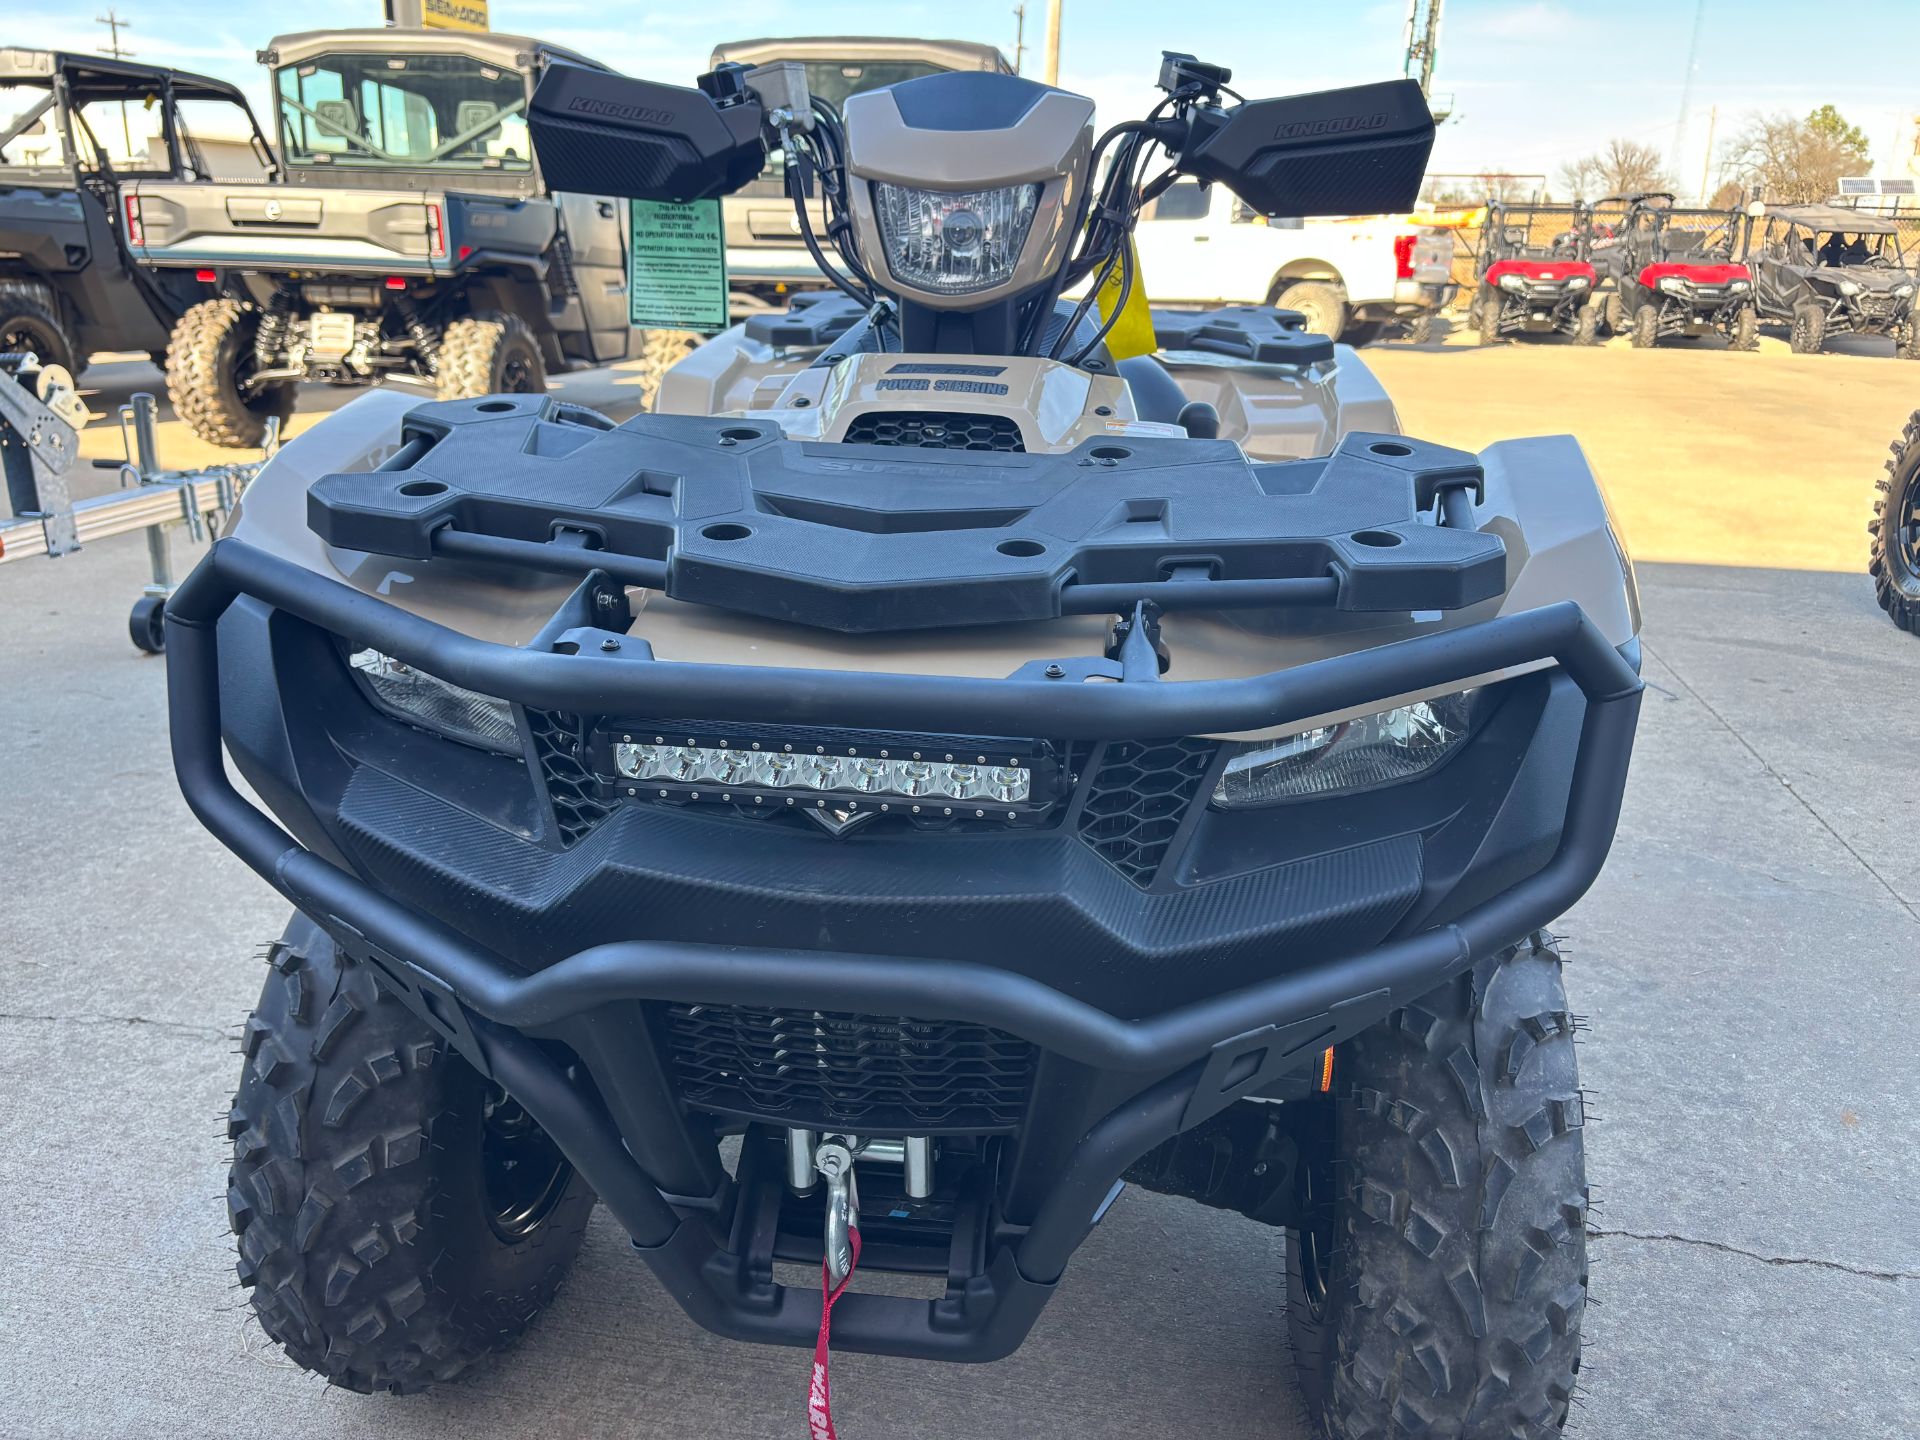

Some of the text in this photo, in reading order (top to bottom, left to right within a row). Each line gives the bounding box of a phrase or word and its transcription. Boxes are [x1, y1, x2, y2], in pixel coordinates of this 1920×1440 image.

[568, 96, 674, 126] KINGQUAD
[1273, 113, 1388, 139] KINGQUAD
[875, 379, 1009, 396] POWER STEERING
